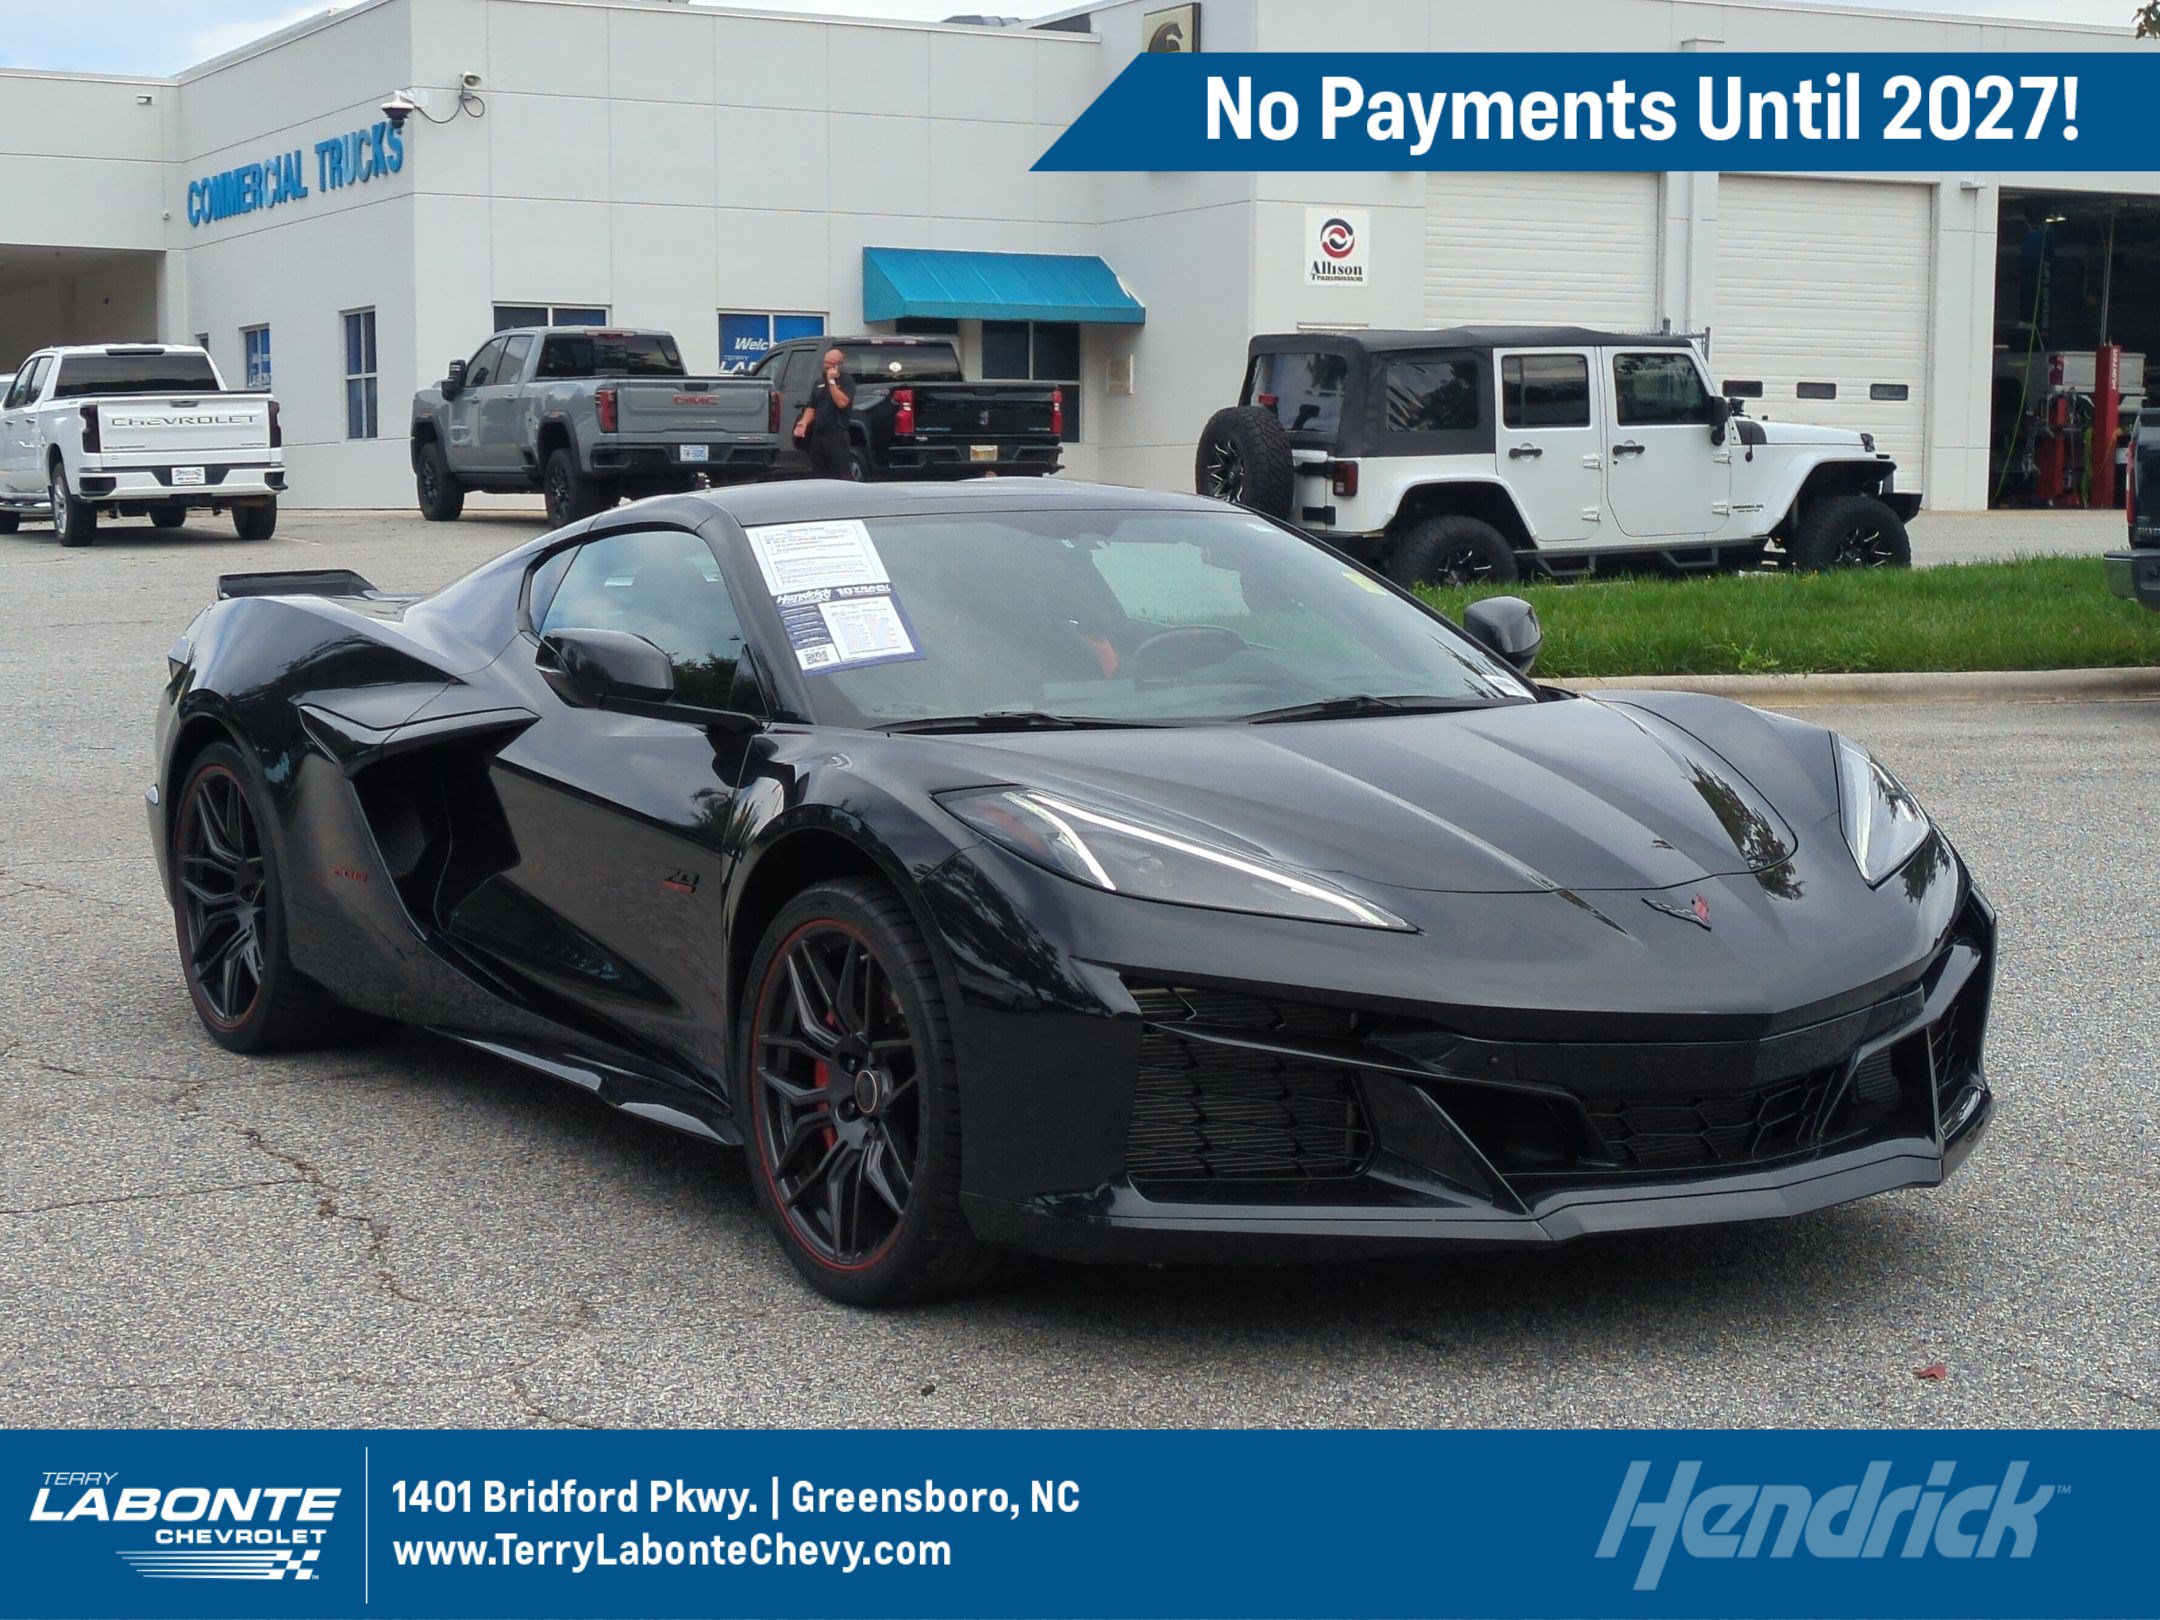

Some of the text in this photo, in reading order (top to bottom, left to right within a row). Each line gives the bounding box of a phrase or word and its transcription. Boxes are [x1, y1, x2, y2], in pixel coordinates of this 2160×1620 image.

[187, 119, 404, 227] COMMERCIAL TRUCKS
[1311, 260, 1363, 276] Allison
[2111, 349, 2119, 391] HUNTER
[672, 394, 720, 405] GMC
[112, 415, 258, 427] CHEVROLET
